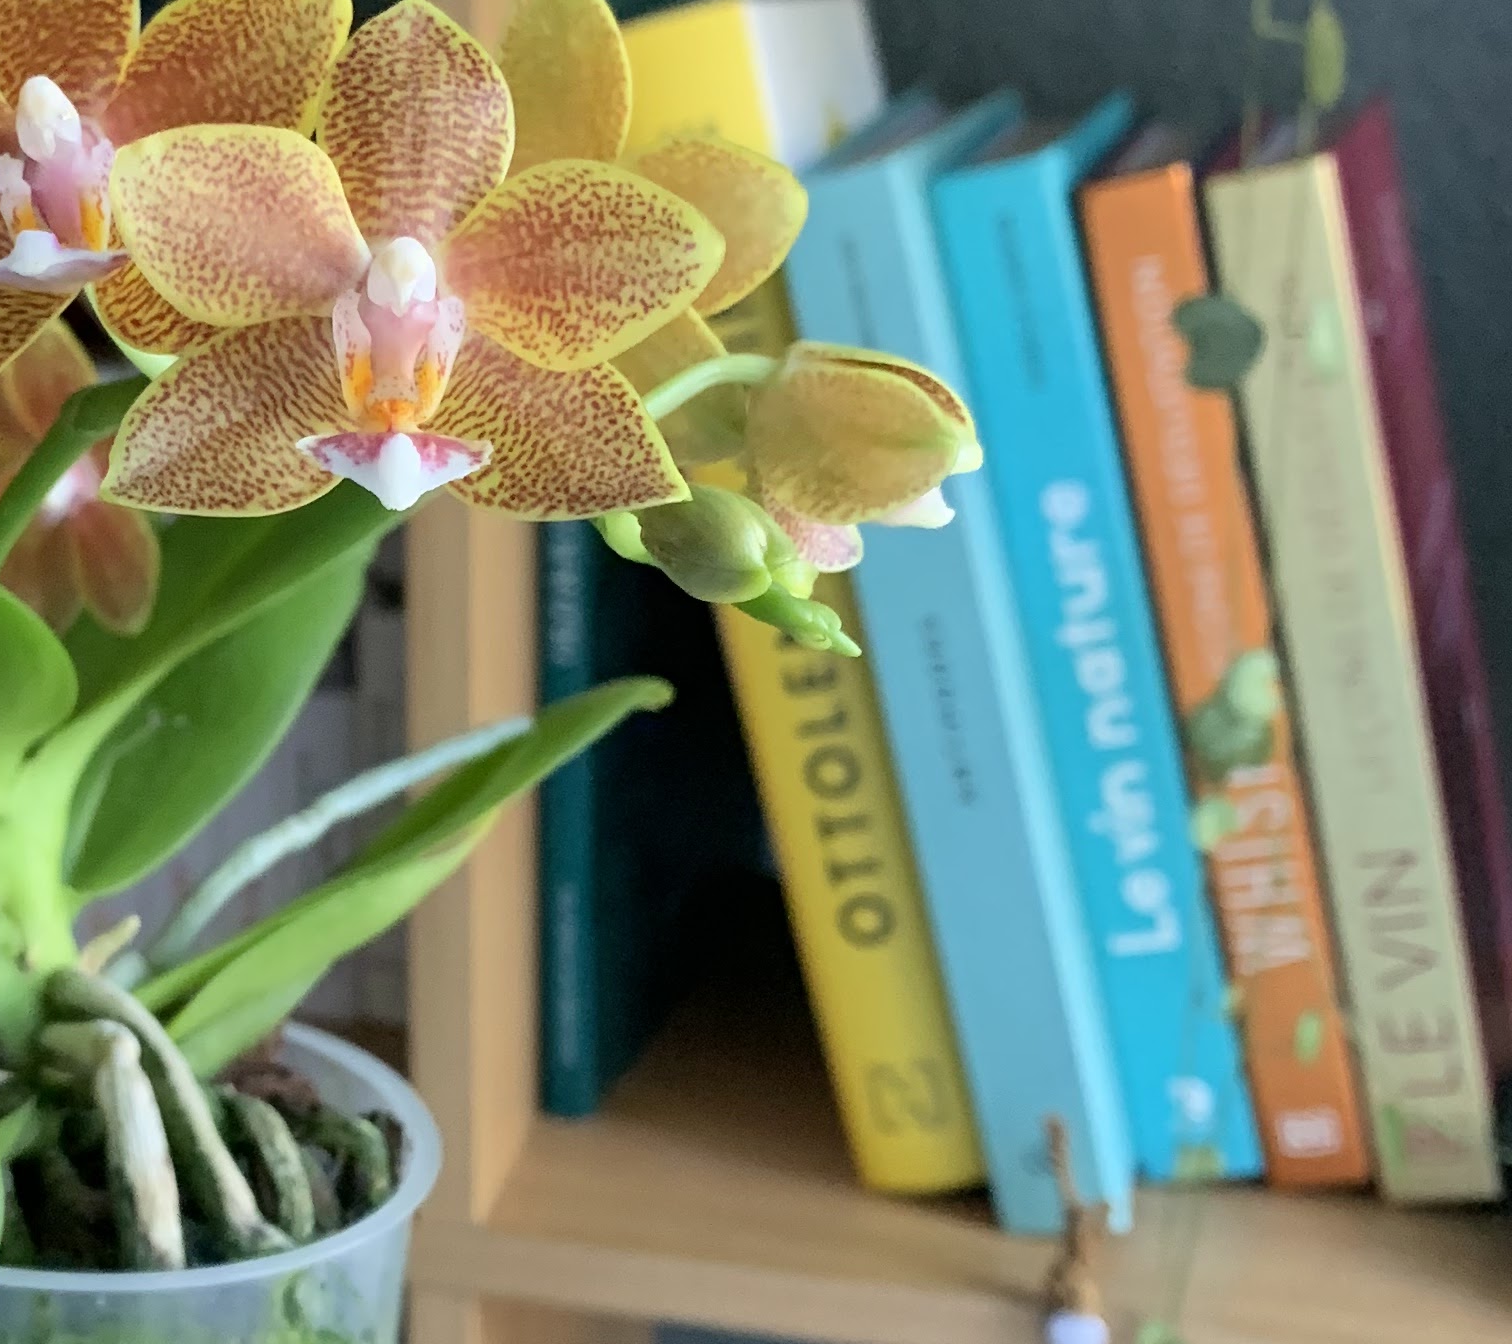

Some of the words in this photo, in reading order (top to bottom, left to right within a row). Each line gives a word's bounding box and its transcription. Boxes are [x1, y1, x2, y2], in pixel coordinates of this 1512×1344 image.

[1040, 478, 1140, 751] nature
[776, 624, 896, 950] OTTOLE
[1086, 759, 1156, 864] vin
[1104, 866, 1179, 958] Le
[1360, 848, 1442, 992] VIN
[1376, 1008, 1467, 1100] LE
